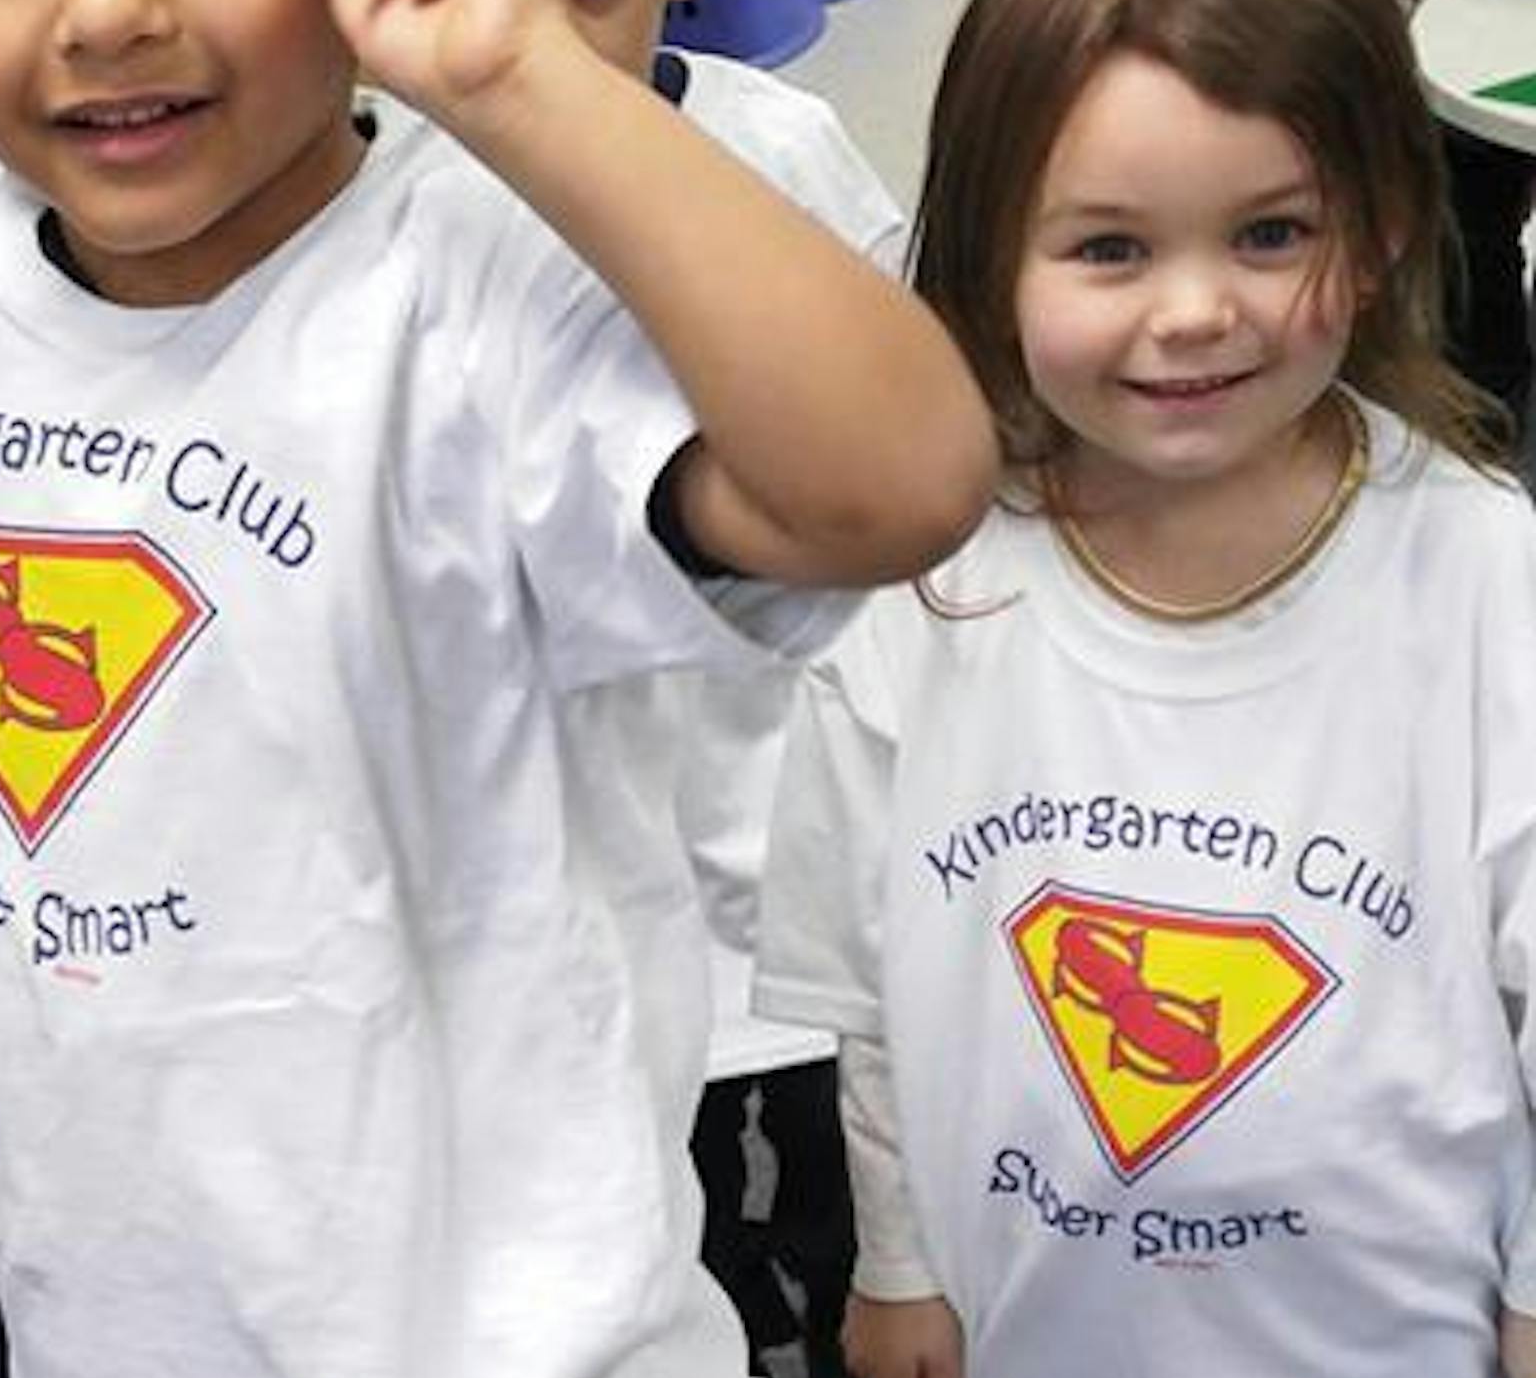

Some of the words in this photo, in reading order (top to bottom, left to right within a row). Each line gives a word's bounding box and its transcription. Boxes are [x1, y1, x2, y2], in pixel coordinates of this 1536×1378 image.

[167, 440, 314, 567] Club
[925, 793, 1278, 900] Kindergarten
[1294, 835, 1416, 941] Club
[33, 890, 196, 964] Smart
[987, 1148, 1116, 1237] Super
[1132, 1207, 1308, 1260] Smart
